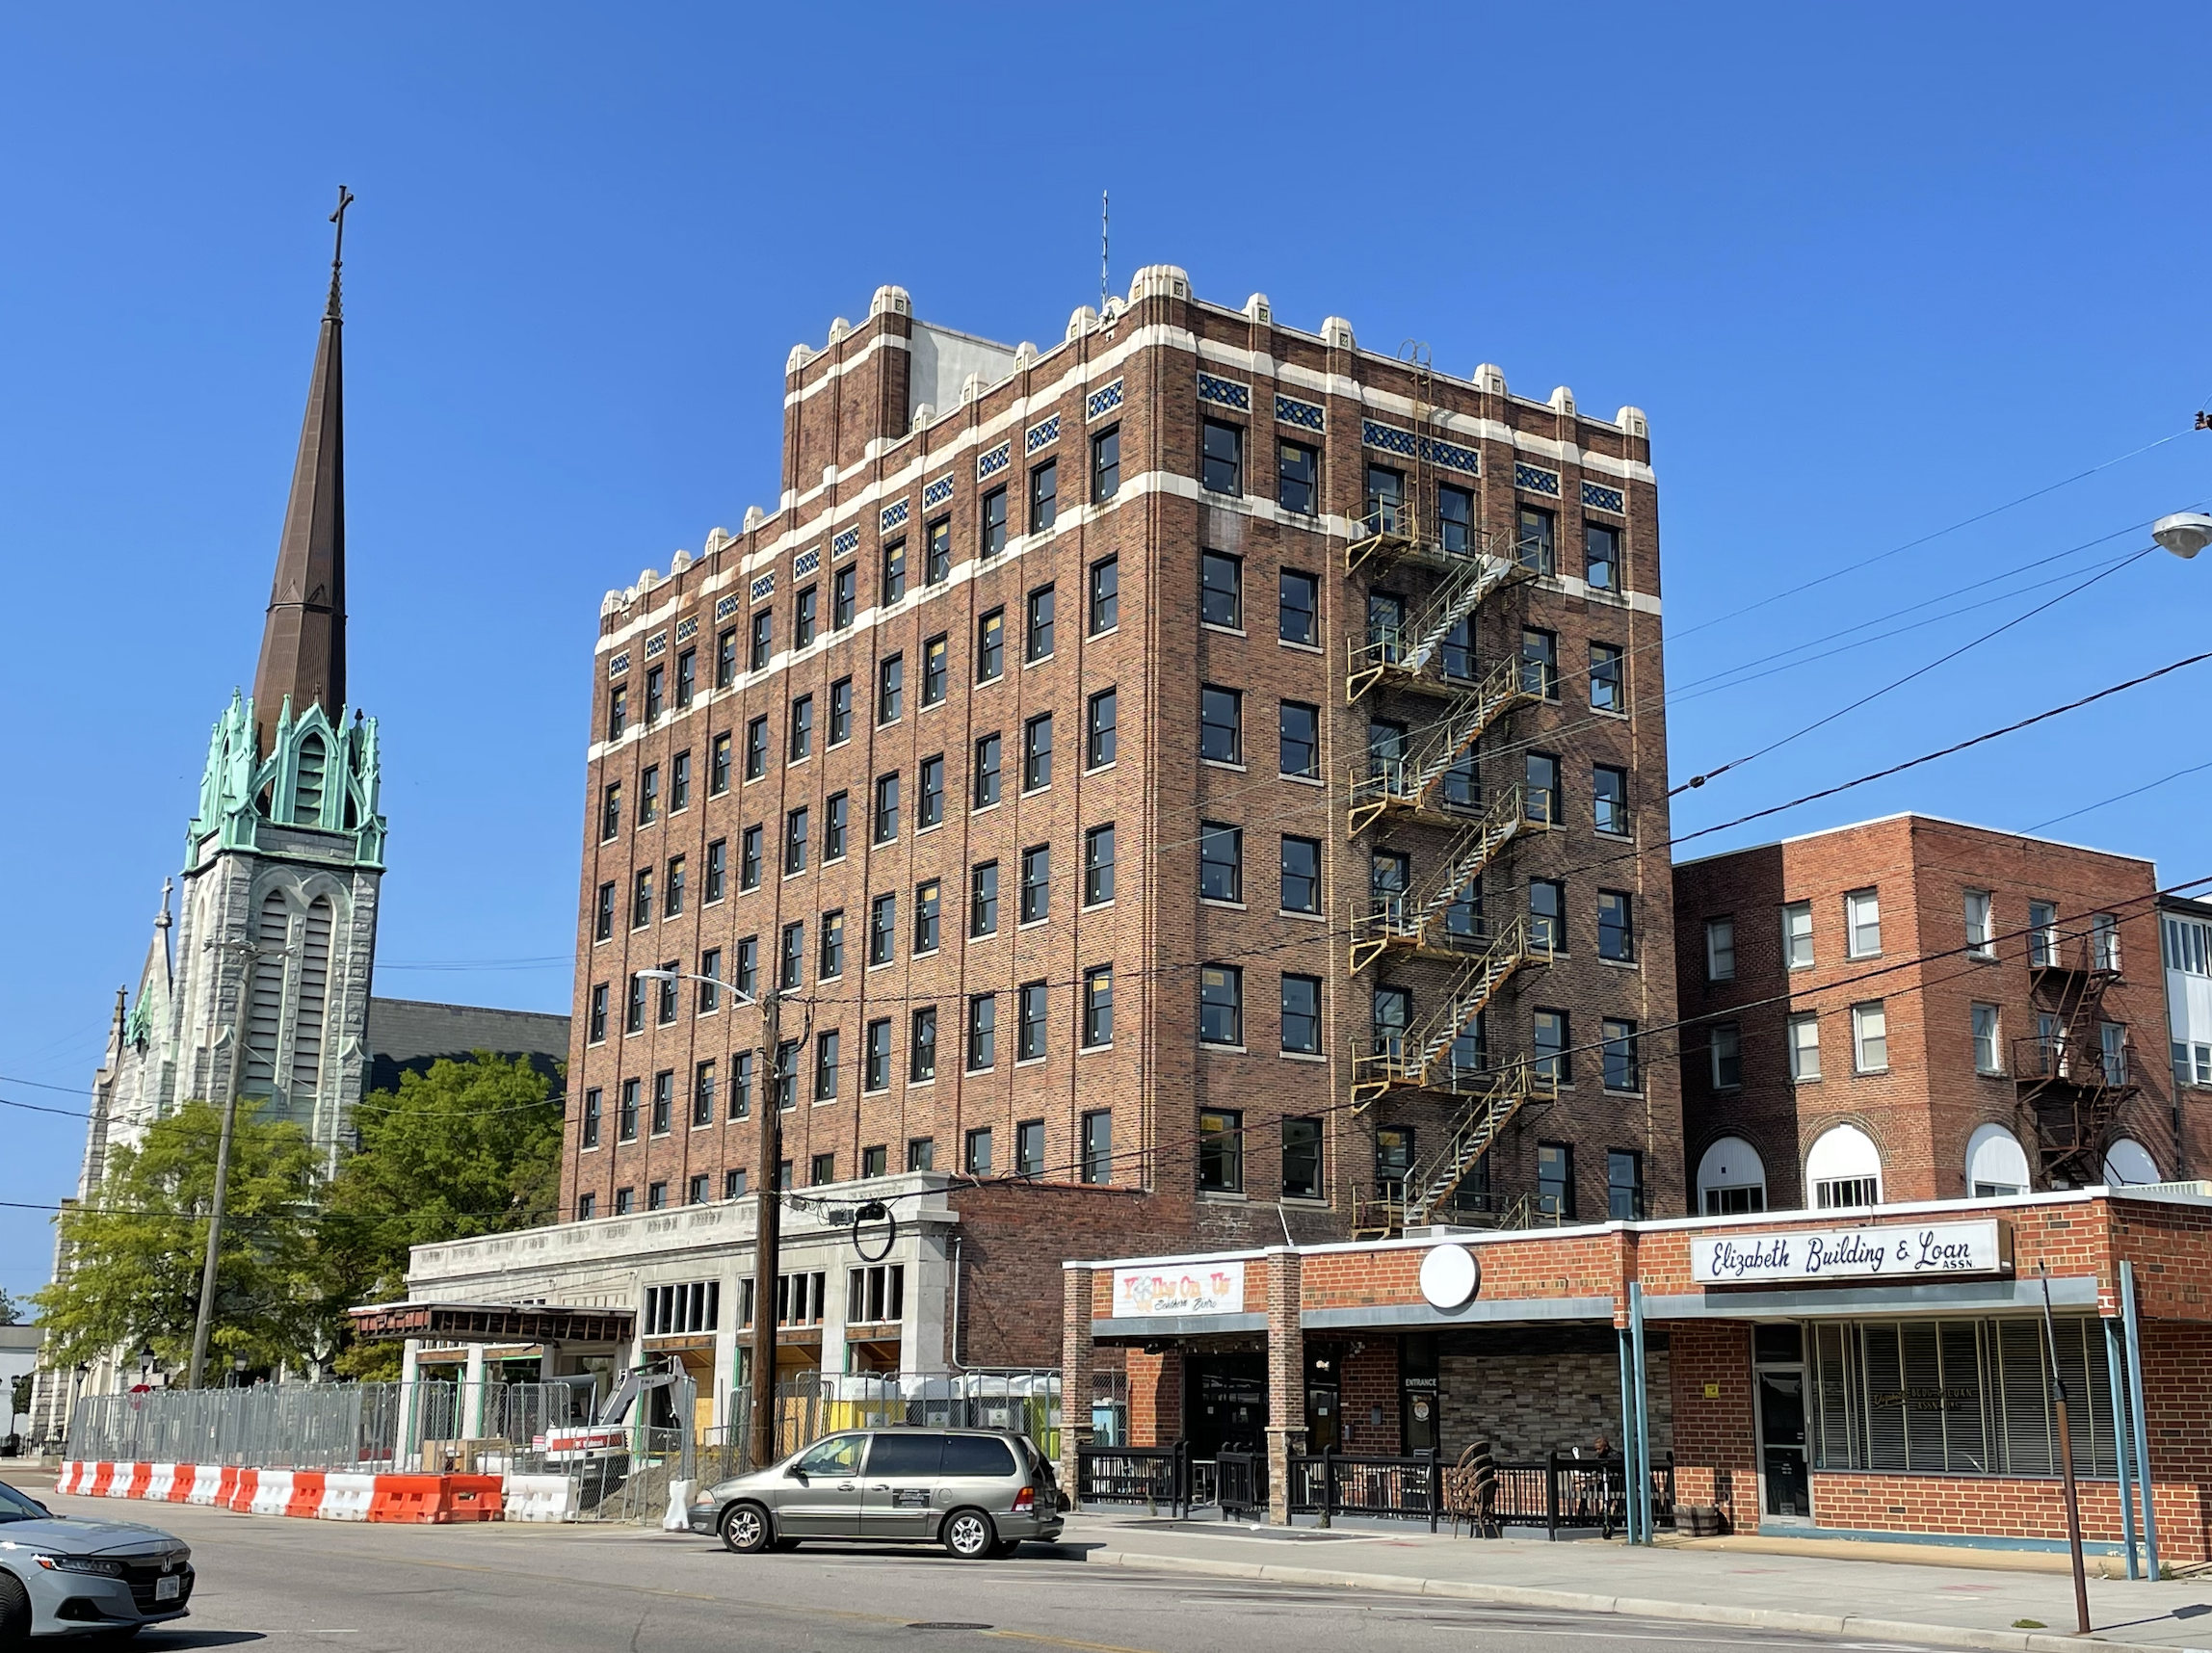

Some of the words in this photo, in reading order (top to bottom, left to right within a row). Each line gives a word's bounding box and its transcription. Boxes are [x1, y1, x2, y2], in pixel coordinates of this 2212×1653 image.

[1712, 1238, 1790, 1275] Elizabeth
[1806, 1235, 1884, 1272] Building
[1896, 1241, 1909, 1260] &
[1914, 1231, 1970, 1269] Loan
[1942, 1259, 1976, 1269] ASSN.
[1406, 1378, 1436, 1386] ENTRANCE
